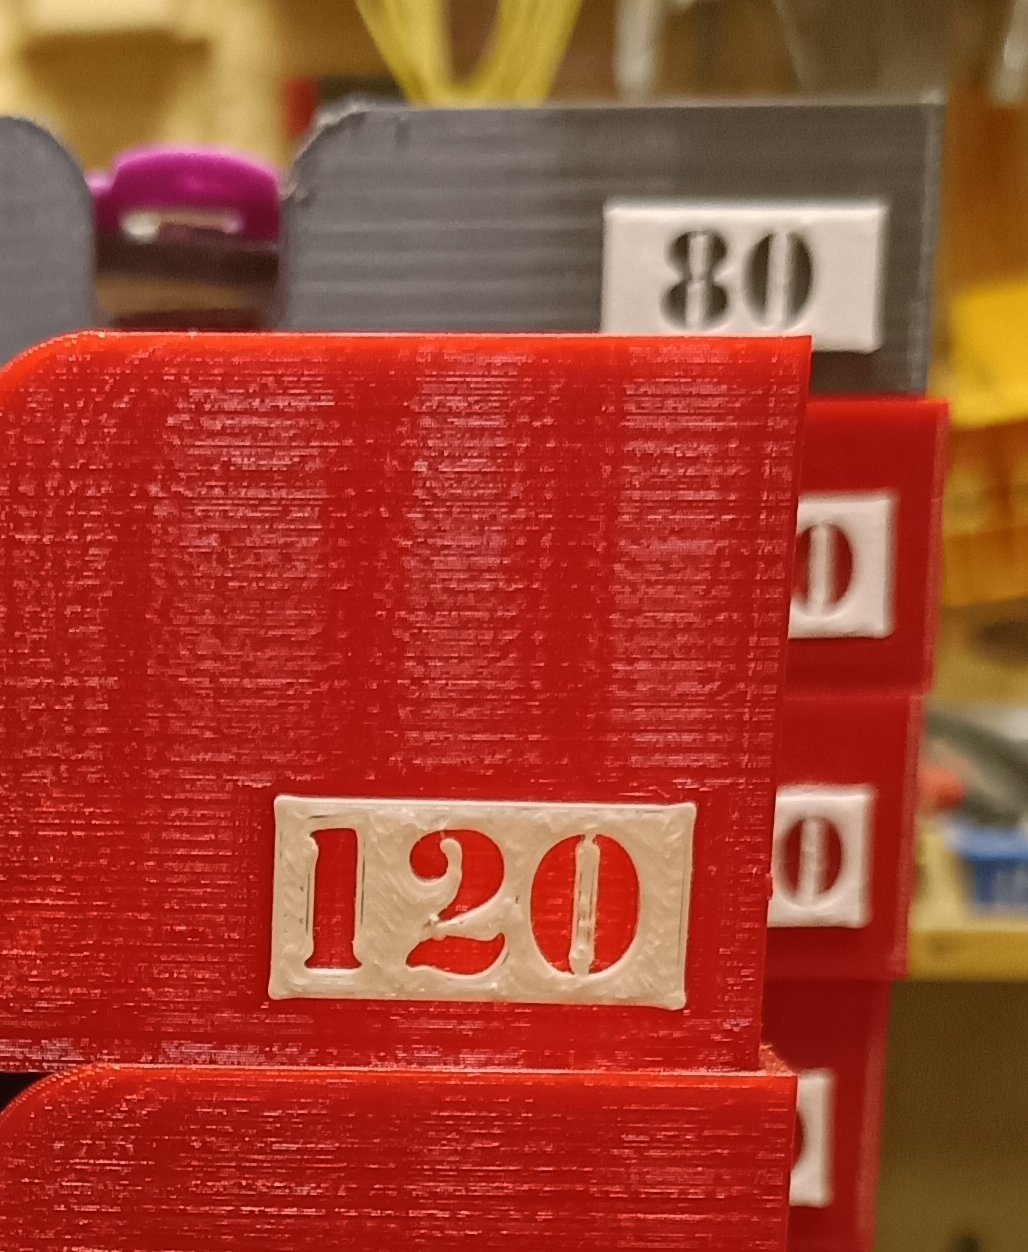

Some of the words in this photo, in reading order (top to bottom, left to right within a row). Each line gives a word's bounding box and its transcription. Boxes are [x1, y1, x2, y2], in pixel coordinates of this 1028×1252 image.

[660, 229, 813, 331] 80
[304, 827, 640, 976] 120
[775, 815, 843, 906] 0
